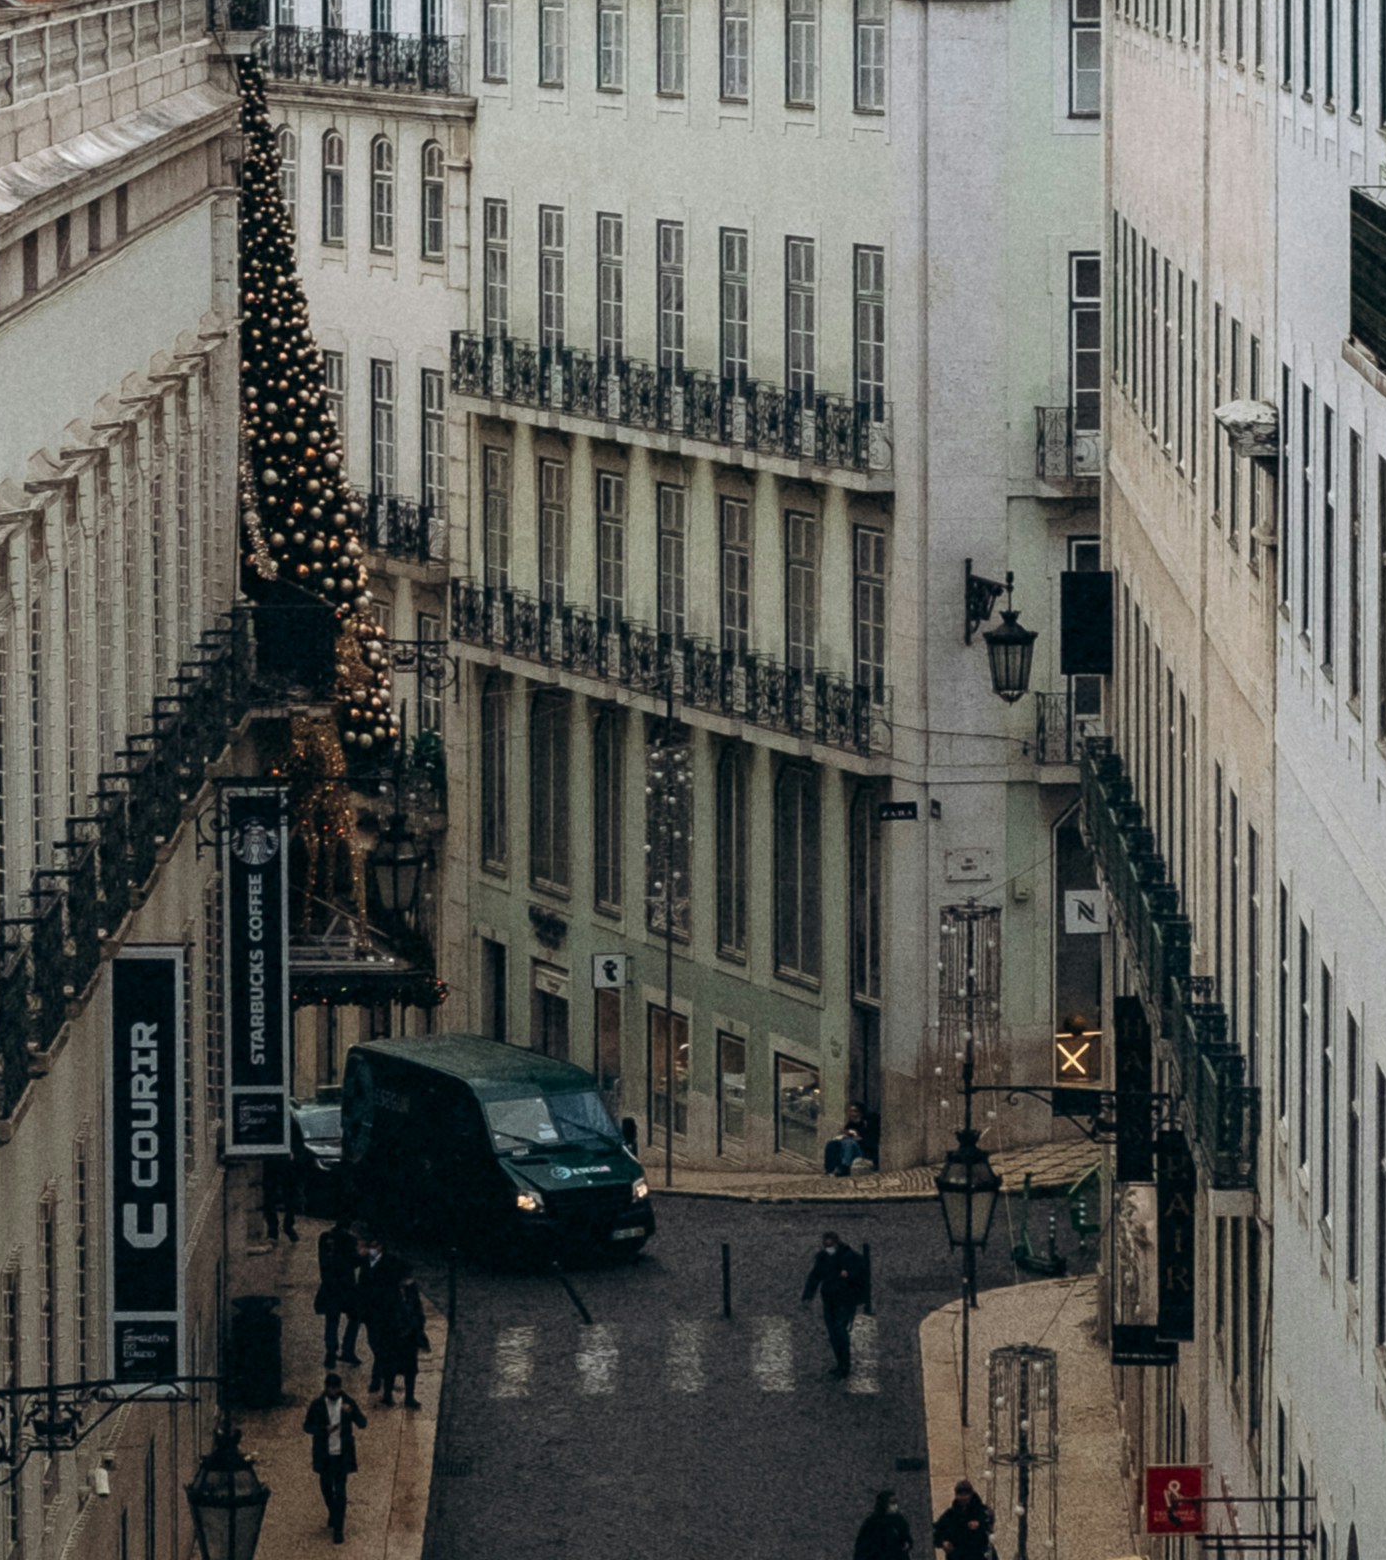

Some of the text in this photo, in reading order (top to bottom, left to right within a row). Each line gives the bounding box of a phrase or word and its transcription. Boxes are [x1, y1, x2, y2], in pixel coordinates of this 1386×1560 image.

[248, 873, 265, 1065] STARBUCKS COFFEE
[130, 1021, 159, 1188] COURIR
[1162, 1154, 1191, 1293] HAIR
